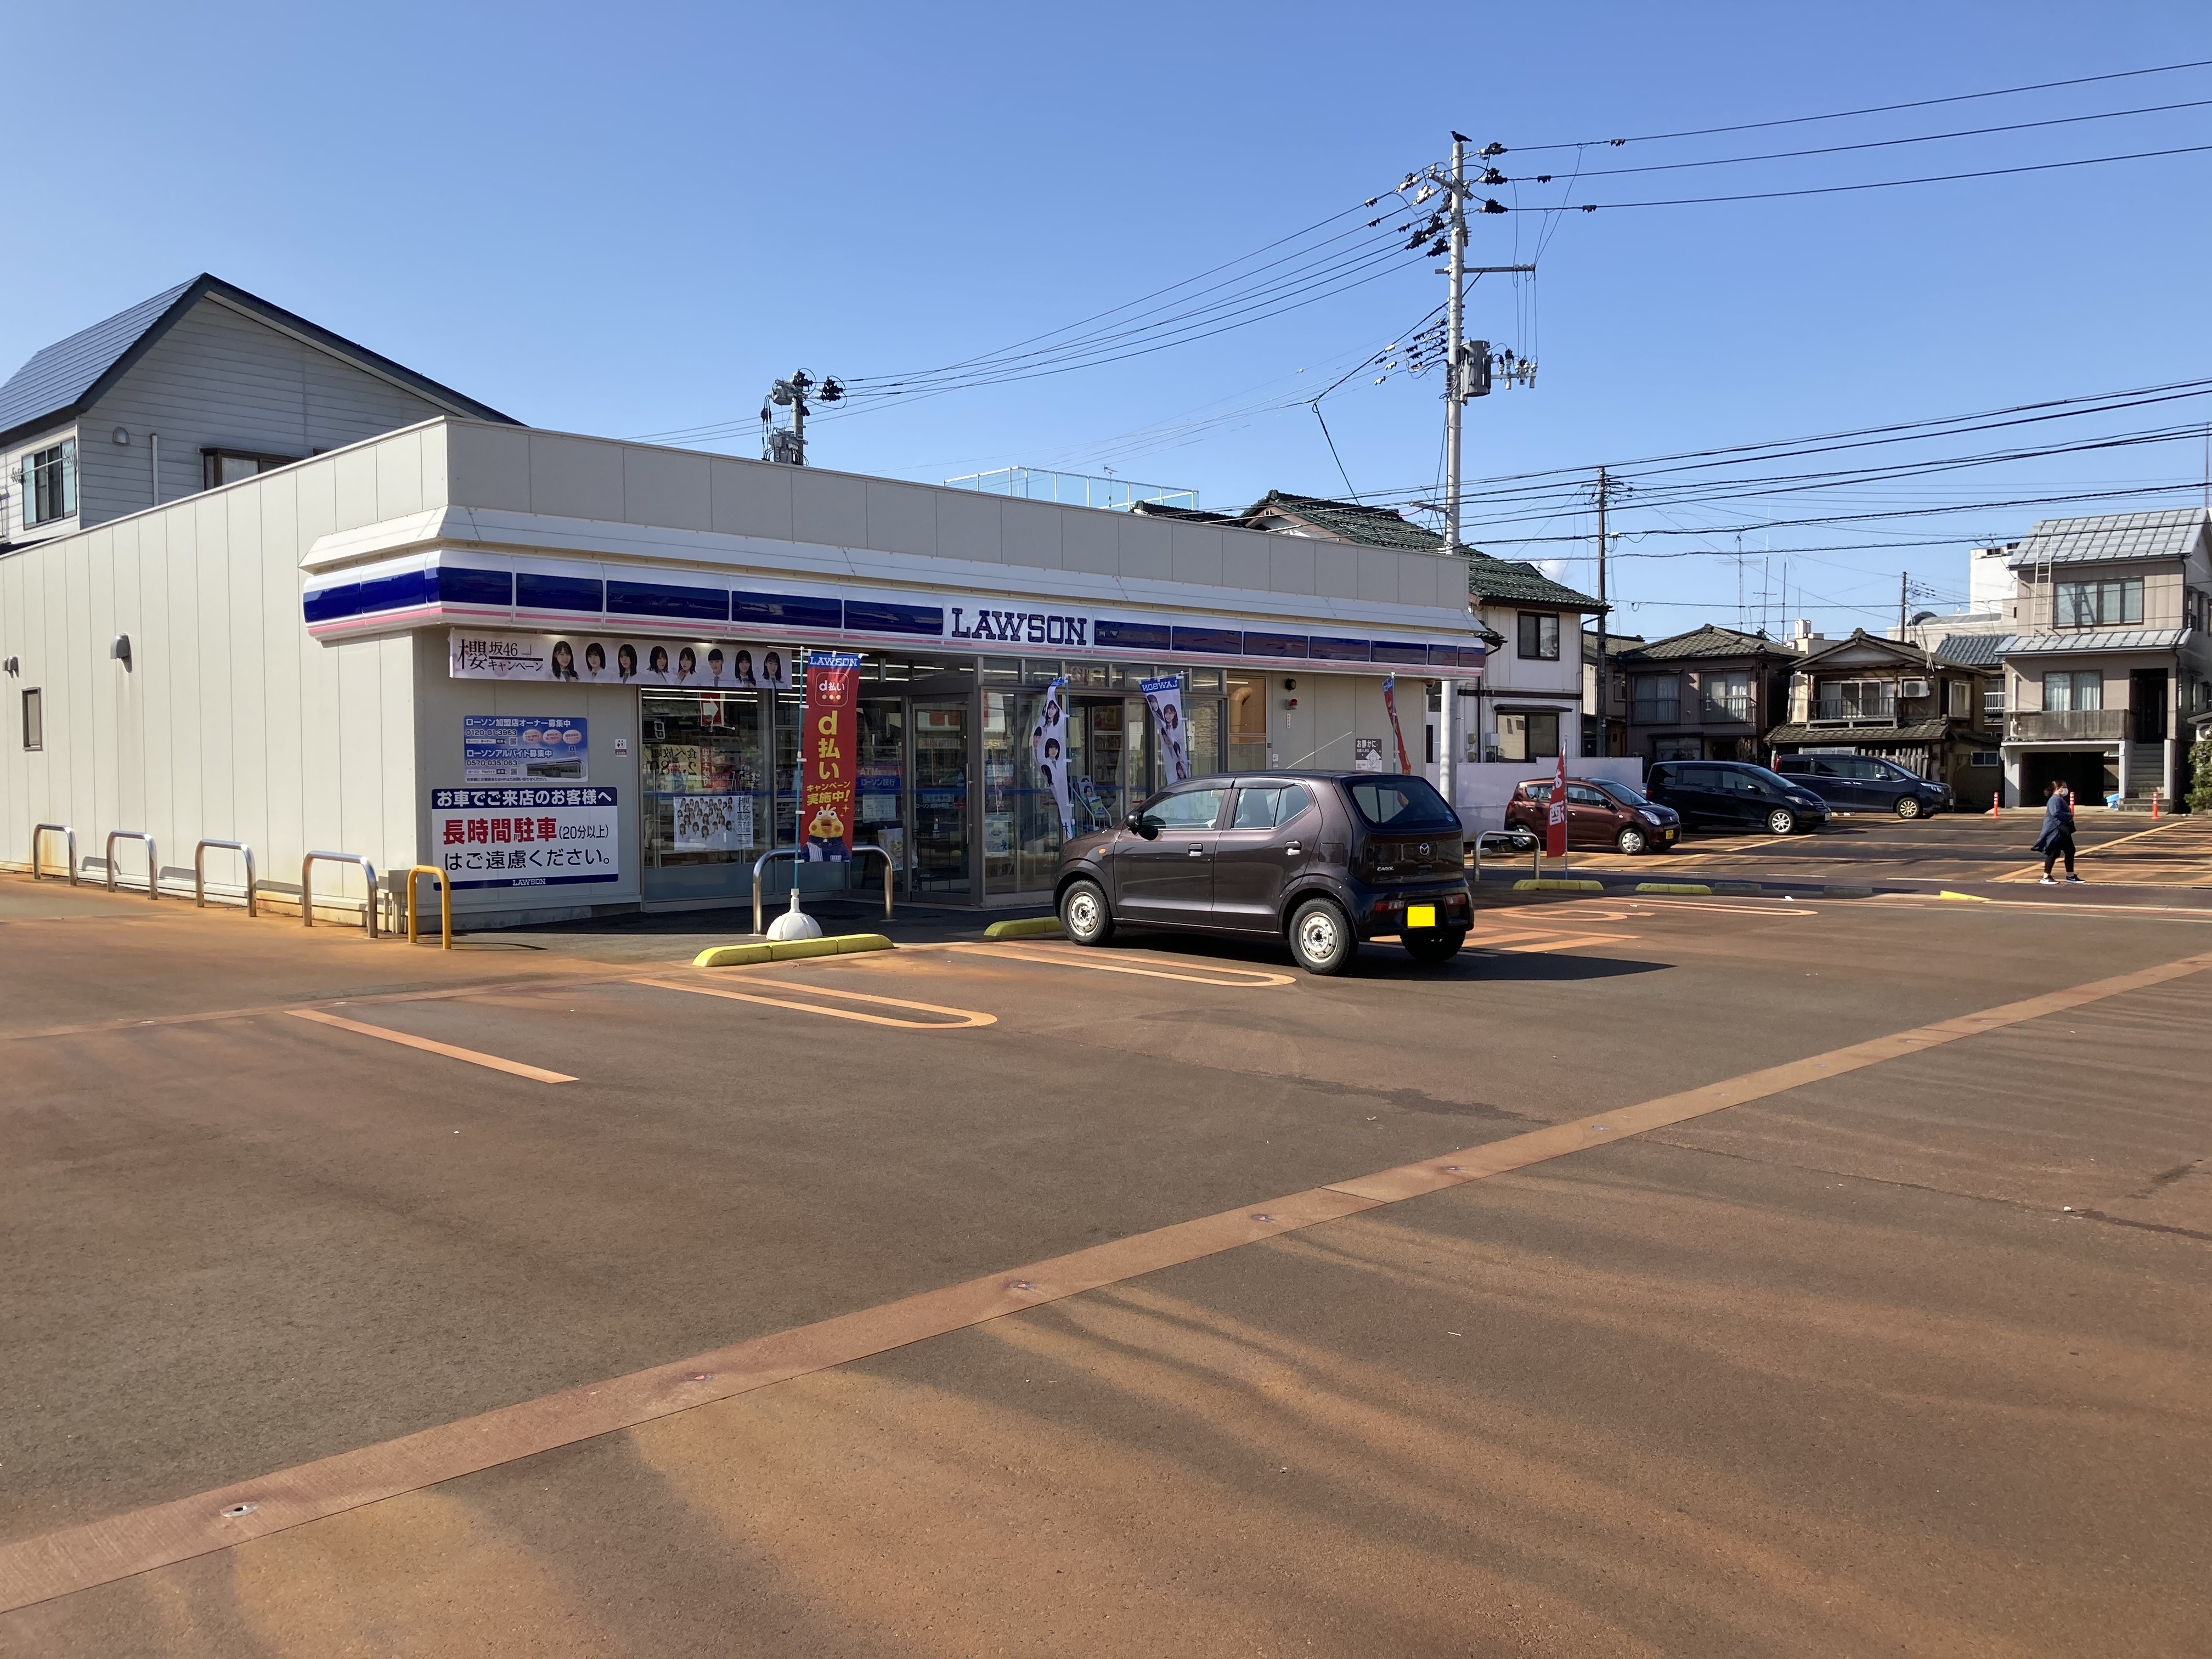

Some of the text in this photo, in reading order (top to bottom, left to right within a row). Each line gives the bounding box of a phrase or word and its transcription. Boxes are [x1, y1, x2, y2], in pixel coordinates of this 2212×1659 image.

[952, 607, 1087, 646] LAWSON
[488, 659, 543, 672] キャンペーン
[810, 656, 858, 667] LAWSON
[819, 680, 845, 691] d払い
[466, 718, 571, 727] ローソン加盟店オーナー募集中
[818, 710, 840, 780] d払い
[466, 749, 553, 758] ローソンアルバイト募集中
[806, 781, 851, 792] キャンペーン
[437, 789, 612, 808] お車でご来店のお客様へ
[443, 816, 557, 845] 長時間駐車
[444, 848, 610, 871] はご遠慮ください。
